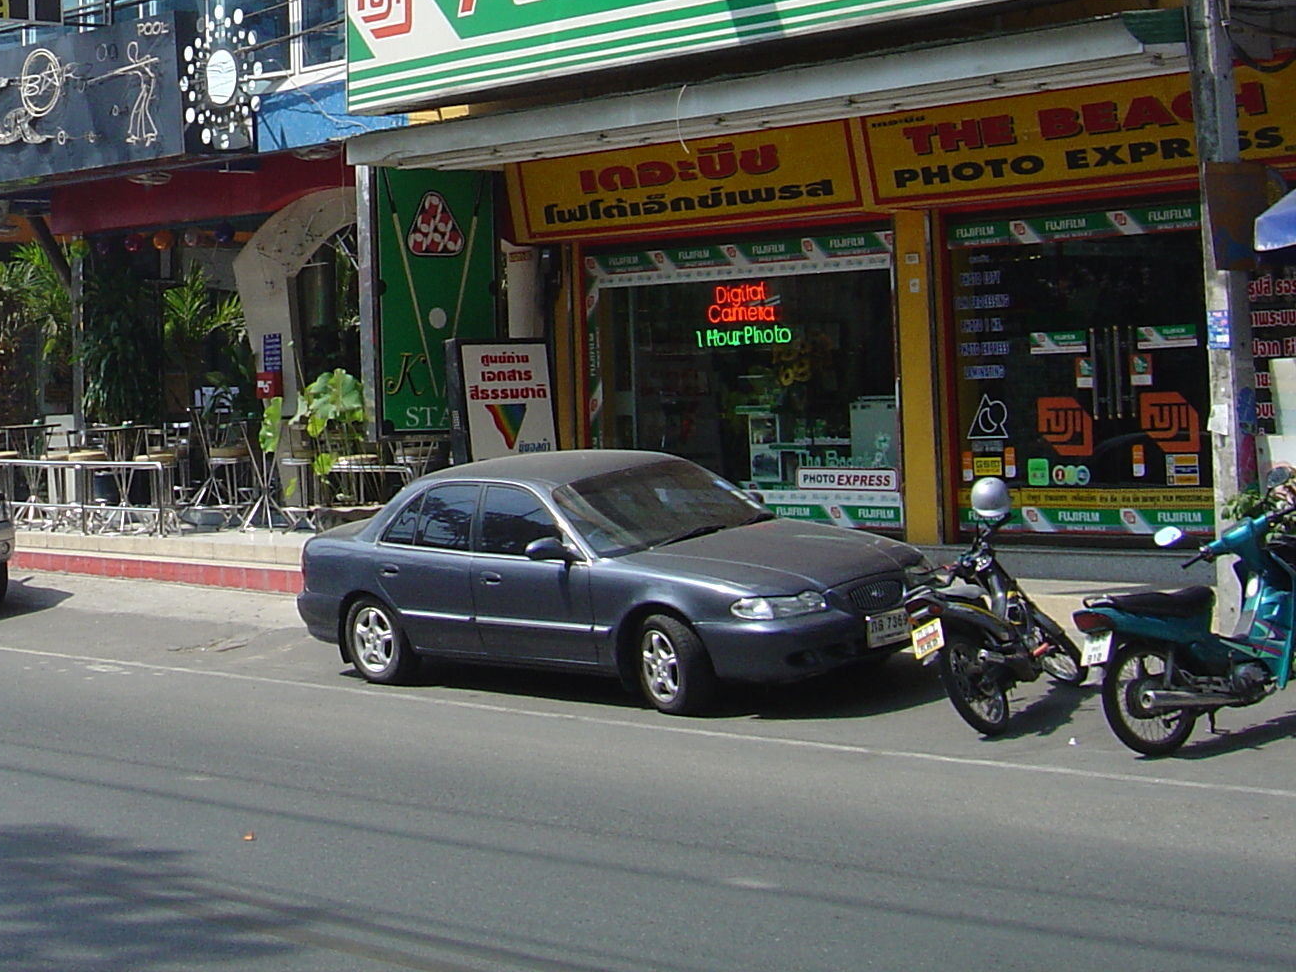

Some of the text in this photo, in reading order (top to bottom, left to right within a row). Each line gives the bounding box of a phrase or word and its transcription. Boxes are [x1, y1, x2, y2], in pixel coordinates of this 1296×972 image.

[136, 21, 168, 37] POOL
[903, 114, 1017, 155] THE
[894, 126, 1285, 190] PHOTO EXPRSS
[579, 142, 781, 196] เดอะบีช
[544, 178, 835, 226] โฟโต้เอ็กซ์เพรส
[1147, 207, 1192, 221] FUJIFILM
[1045, 218, 1086, 231] FUJIFILM
[955, 225, 995, 238] FUJIFILM
[751, 243, 786, 255] FUJIFILM
[828, 236, 866, 249] FUJIFILM
[608, 255, 639, 266] FUJIFILM
[678, 249, 710, 260] FUJIFILM
[715, 281, 767, 307] Digital
[708, 304, 776, 324] Camera
[695, 325, 792, 348] 1 Hour Photo
[481, 351, 530, 367] ศูนย์ถ่าย
[481, 369, 533, 382] เอกสาร
[468, 383, 547, 401] สีธรรมชาติ
[803, 474, 891, 487] PHOTO EXPRESS
[775, 506, 811, 518] FUJIFILM
[858, 508, 895, 519] FUJIFILM
[1058, 510, 1101, 522] FUJIFILM
[1157, 511, 1203, 523] FUJIFILM
